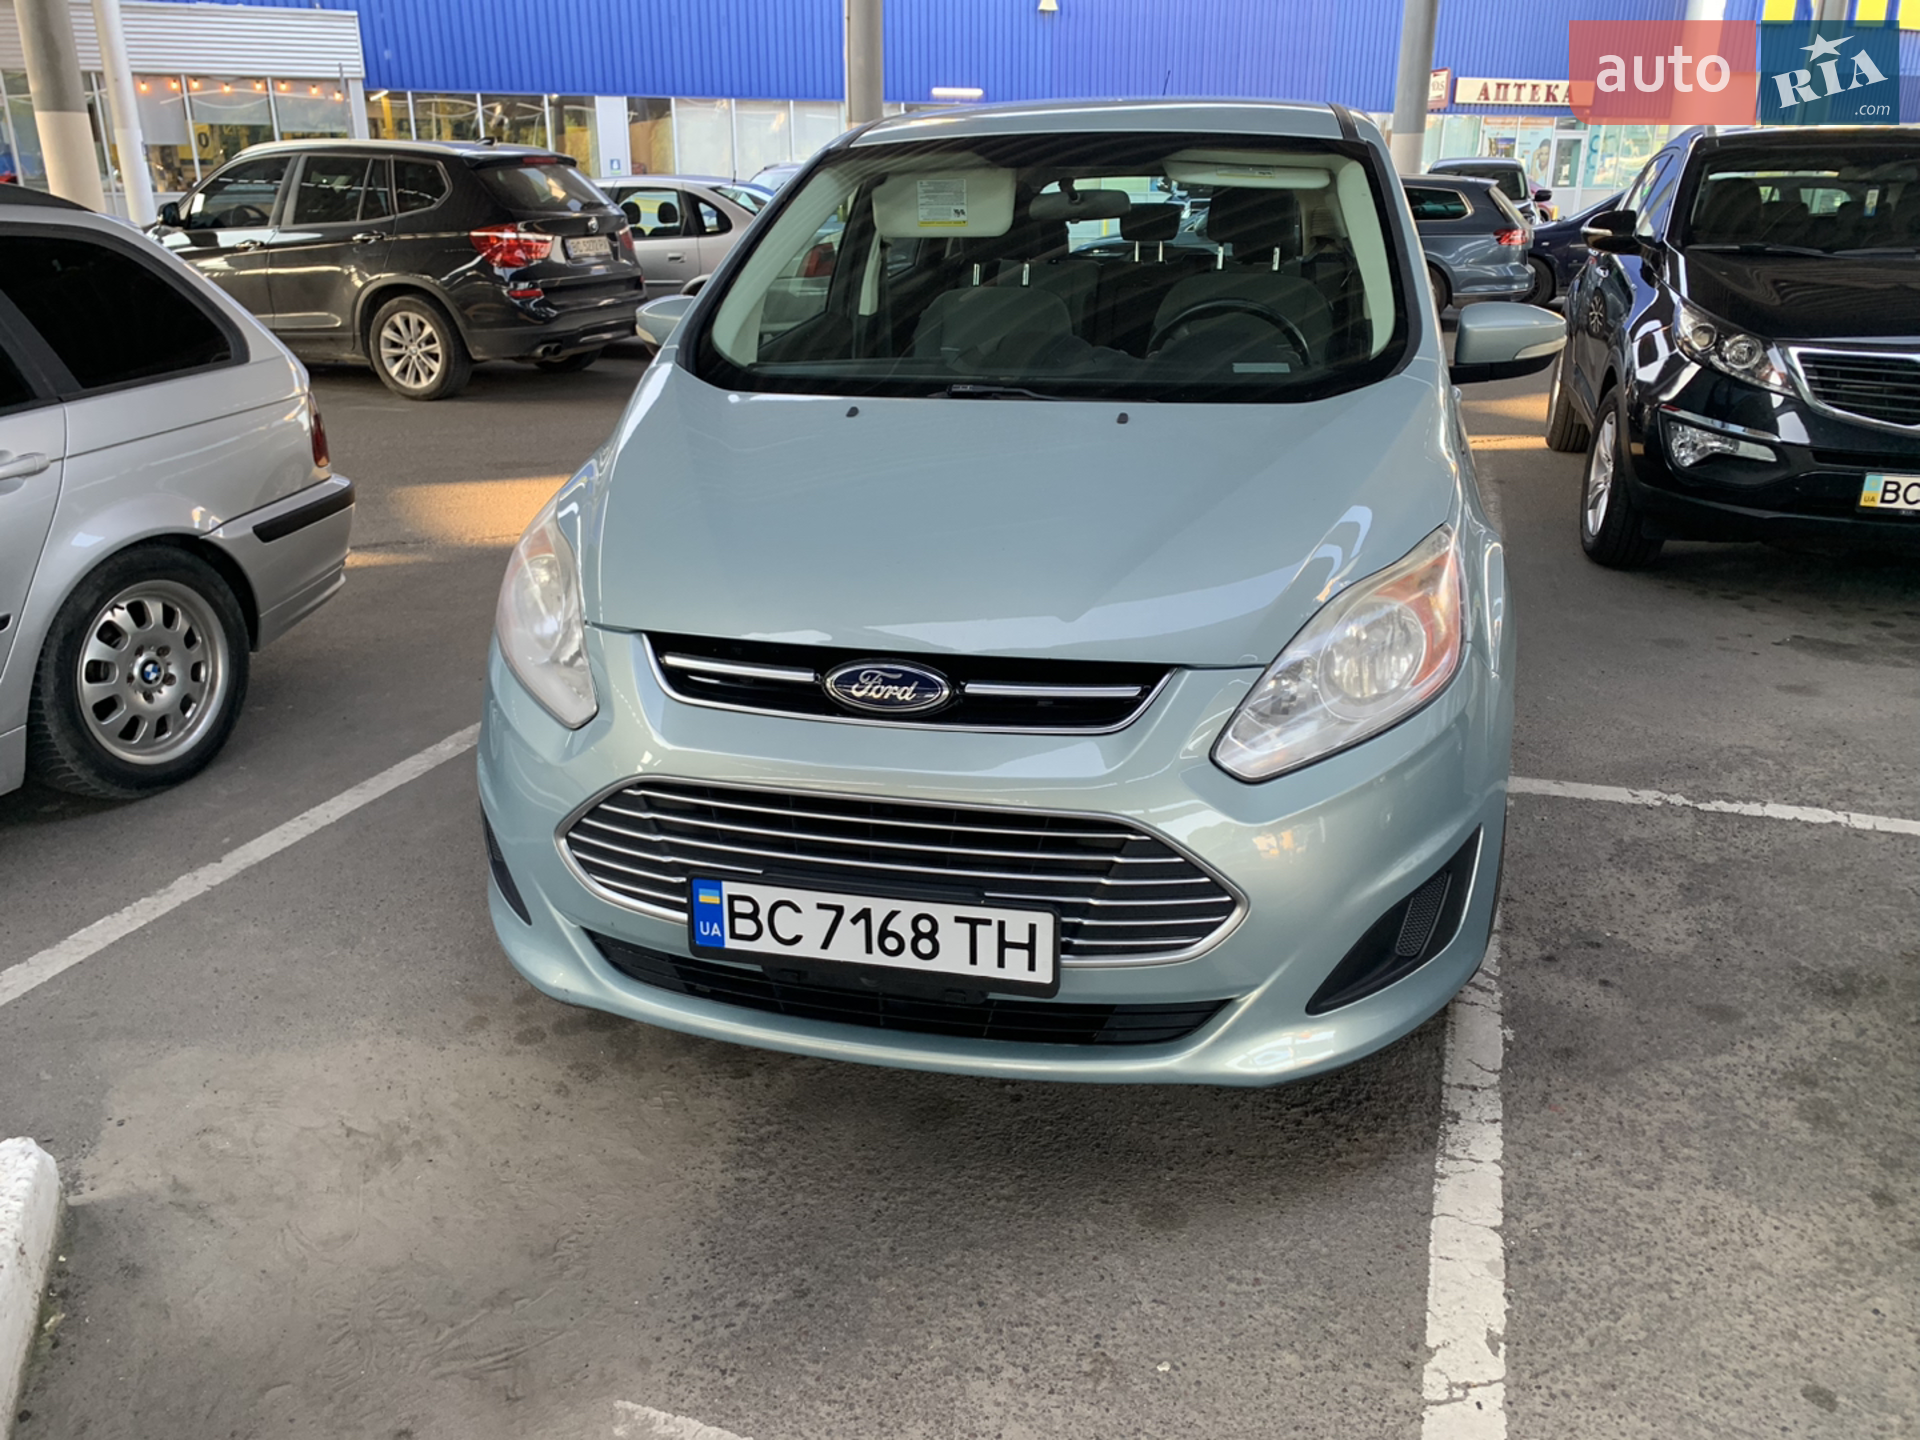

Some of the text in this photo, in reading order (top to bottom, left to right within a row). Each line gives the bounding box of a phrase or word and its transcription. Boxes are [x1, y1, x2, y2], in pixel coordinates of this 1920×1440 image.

[1476, 81, 1574, 103] АПТЕКА
[1863, 495, 1876, 503] UA
[1880, 480, 1920, 505] BC
[850, 669, 919, 701] Ford
[699, 920, 722, 937] UA
[726, 892, 1037, 973] BC 7168 TH
